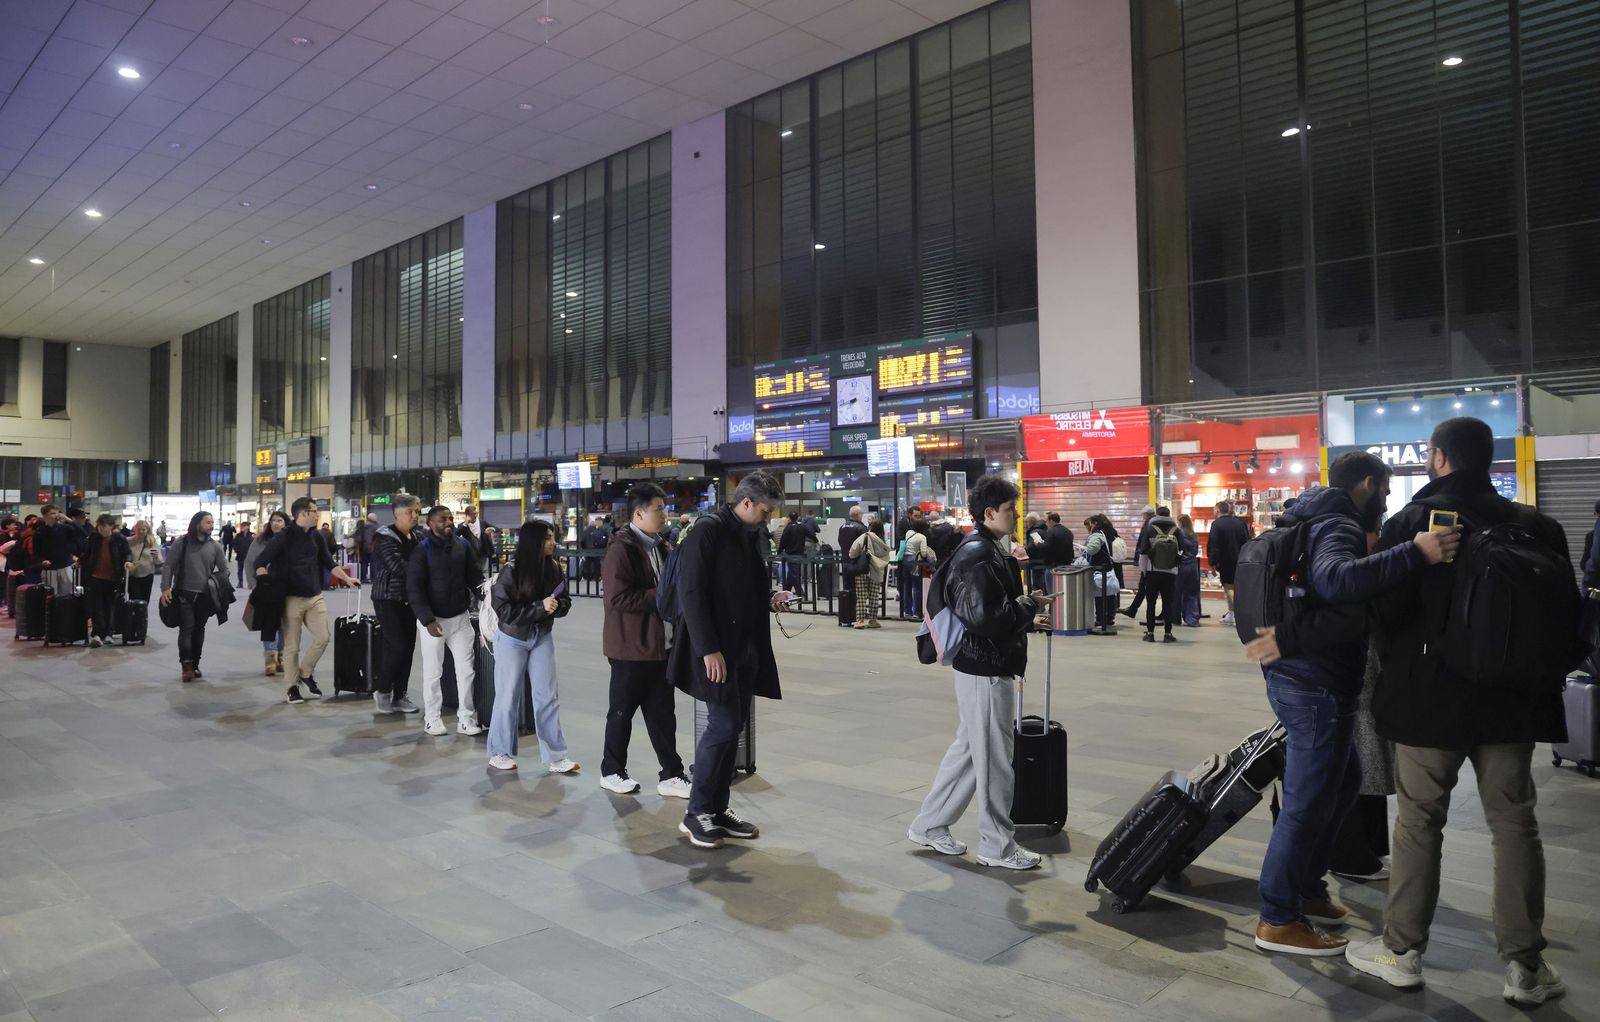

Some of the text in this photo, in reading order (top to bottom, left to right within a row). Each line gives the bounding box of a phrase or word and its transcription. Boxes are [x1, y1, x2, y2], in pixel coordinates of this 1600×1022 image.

[840, 351, 867, 362] TRENES ALTA
[842, 360, 865, 370] VELOCIDAD
[842, 433, 868, 442] HIGH SPEED
[847, 441, 863, 450] TRAINS
[1068, 459, 1094, 476] RELAY
[953, 483, 962, 505] A
